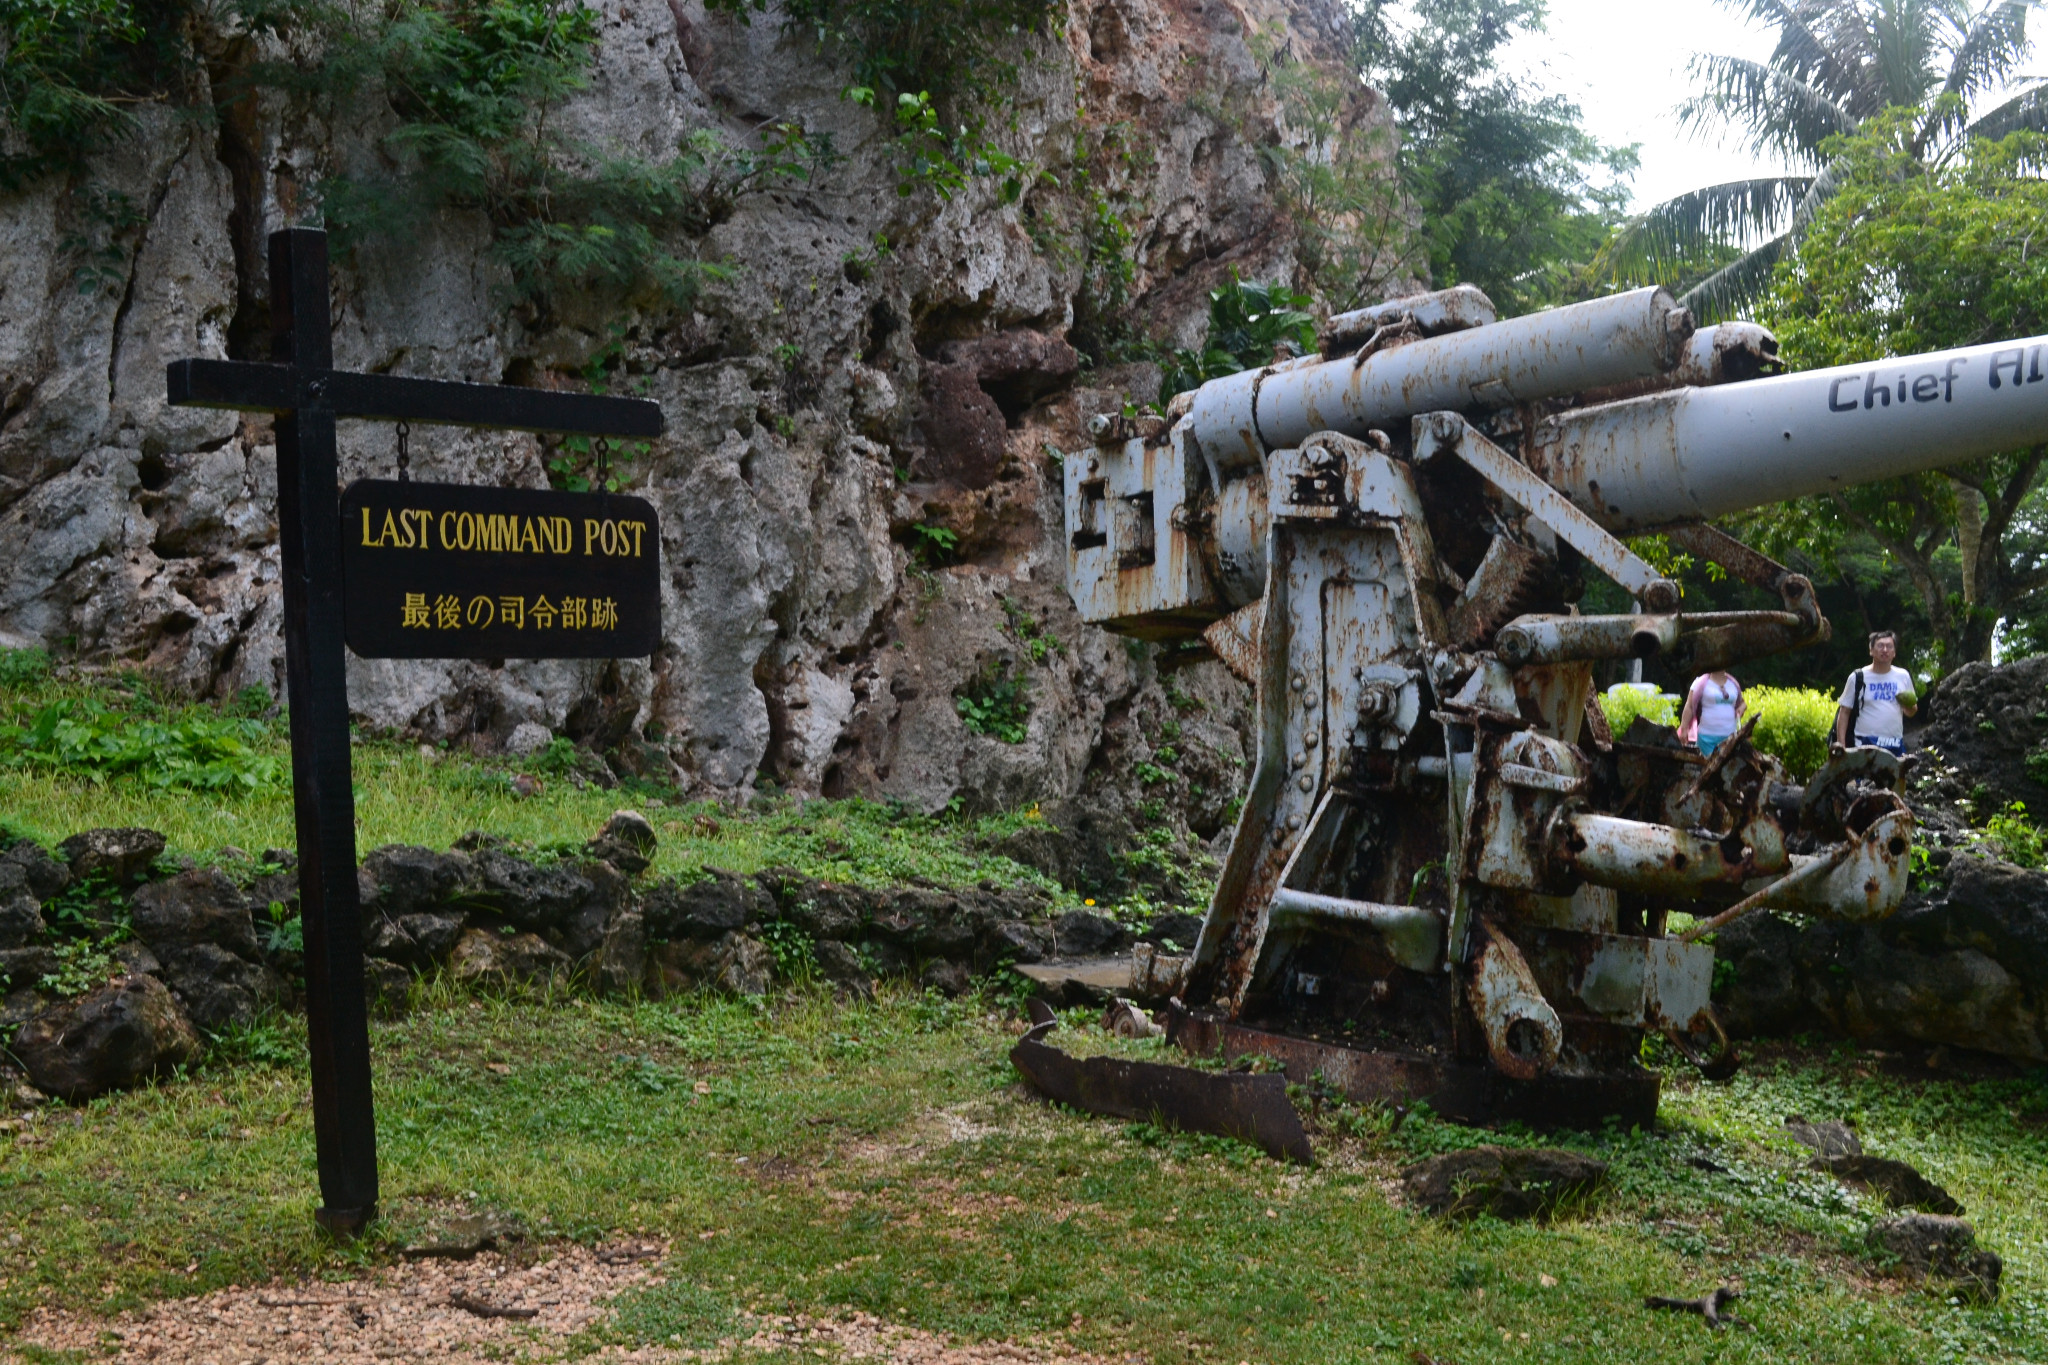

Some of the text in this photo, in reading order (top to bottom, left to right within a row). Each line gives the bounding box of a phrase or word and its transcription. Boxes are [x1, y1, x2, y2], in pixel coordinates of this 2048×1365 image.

[1828, 357, 1967, 412] Chief
[361, 507, 646, 557] LAST COMMAND POST
[401, 592, 618, 631] 最後の司令部跡
[1876, 736, 1901, 747] NIKE
